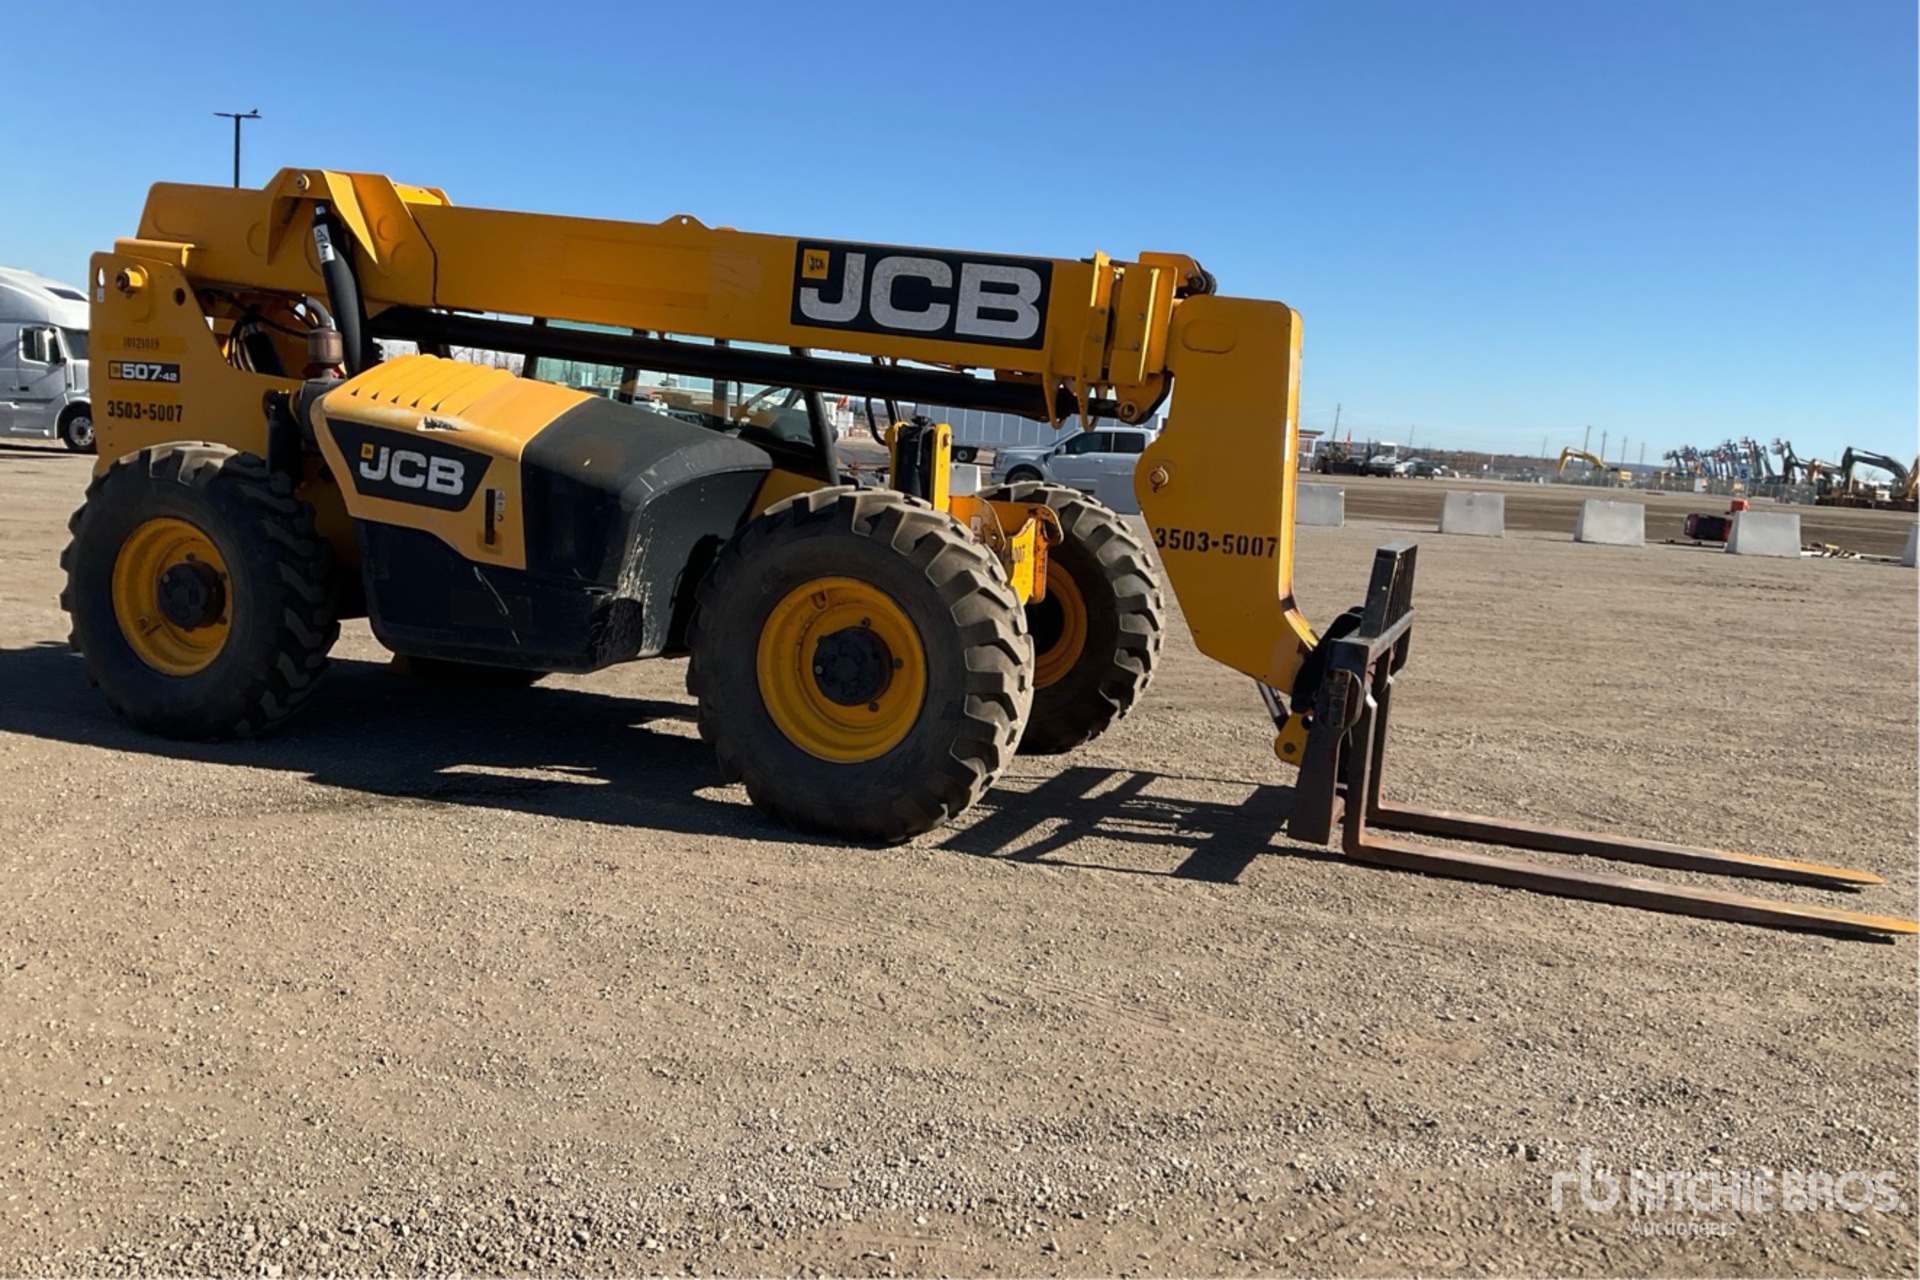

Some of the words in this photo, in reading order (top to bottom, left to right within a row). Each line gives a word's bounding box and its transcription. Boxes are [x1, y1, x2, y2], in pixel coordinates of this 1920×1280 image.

[799, 252, 1042, 340] JCB
[107, 400, 183, 422] 3503-5007
[360, 446, 465, 496] JCB
[1155, 527, 1278, 558] 3503-5007
